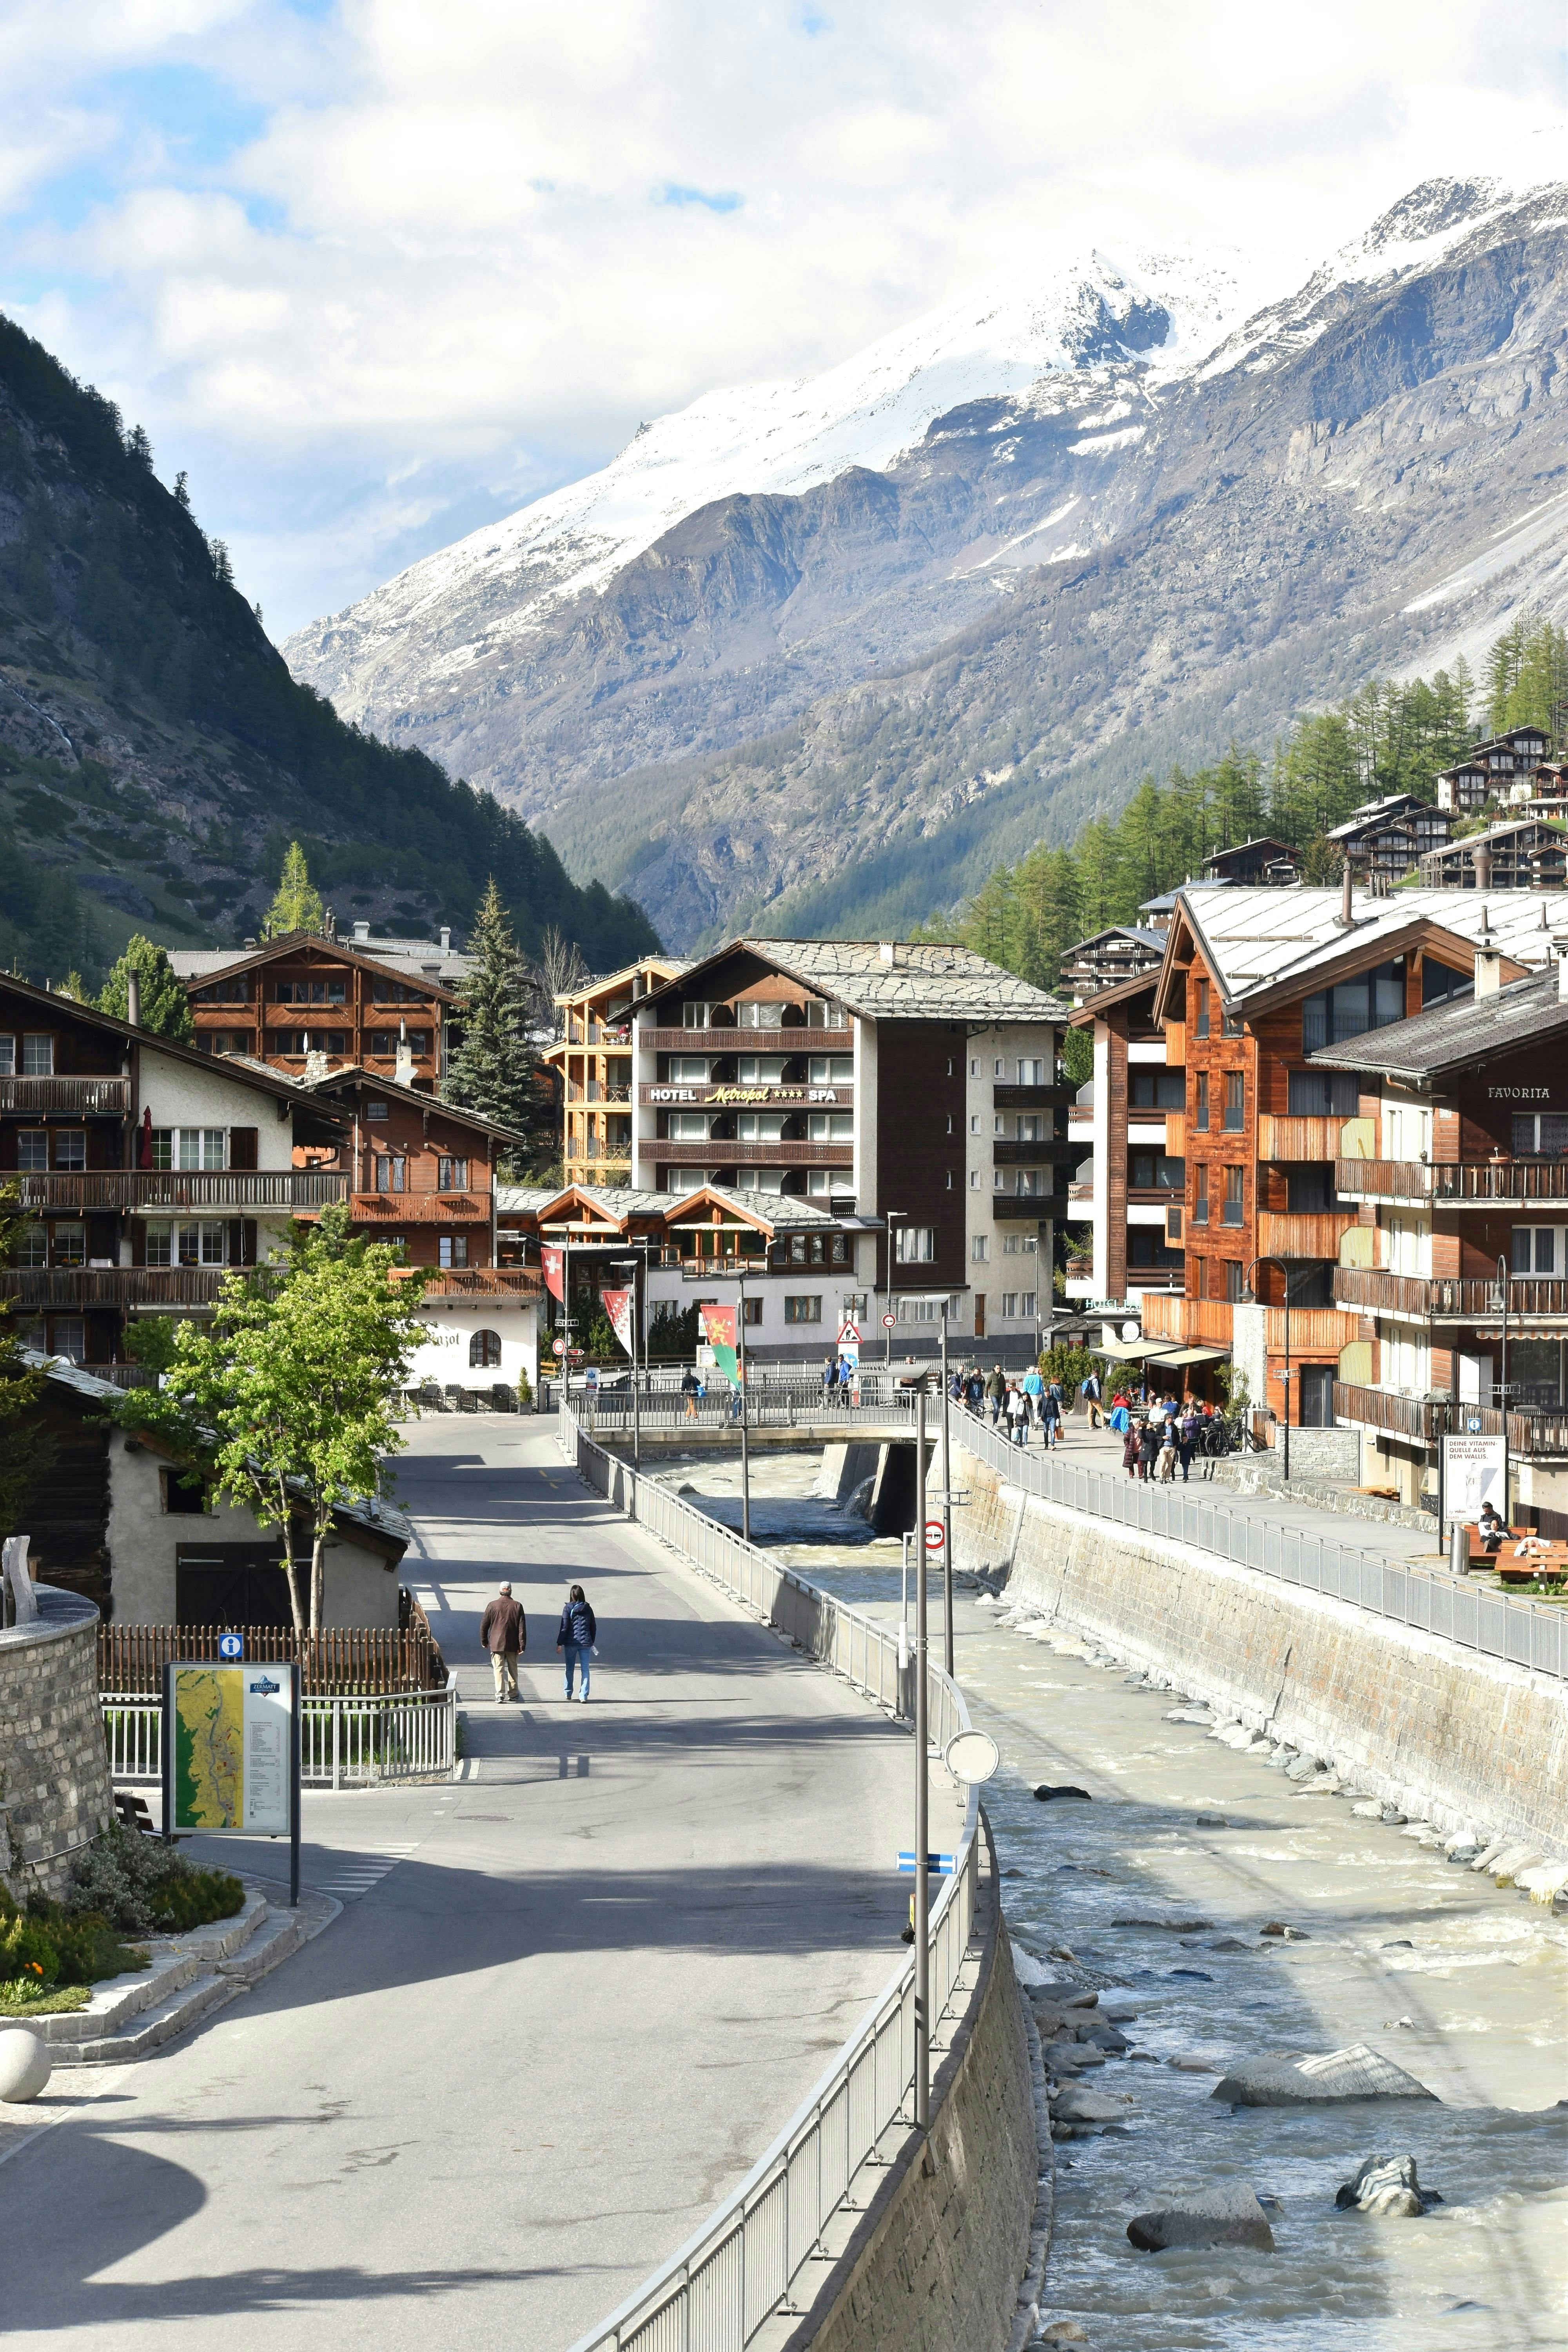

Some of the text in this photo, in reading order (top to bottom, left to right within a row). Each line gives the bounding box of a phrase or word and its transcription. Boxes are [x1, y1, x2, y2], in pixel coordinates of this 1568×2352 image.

[651, 1086, 836, 1104] HOTEL Metropol SPA
[1488, 1087, 1550, 1098] FAVORITA
[1085, 1298, 1120, 1308] HOTEL
